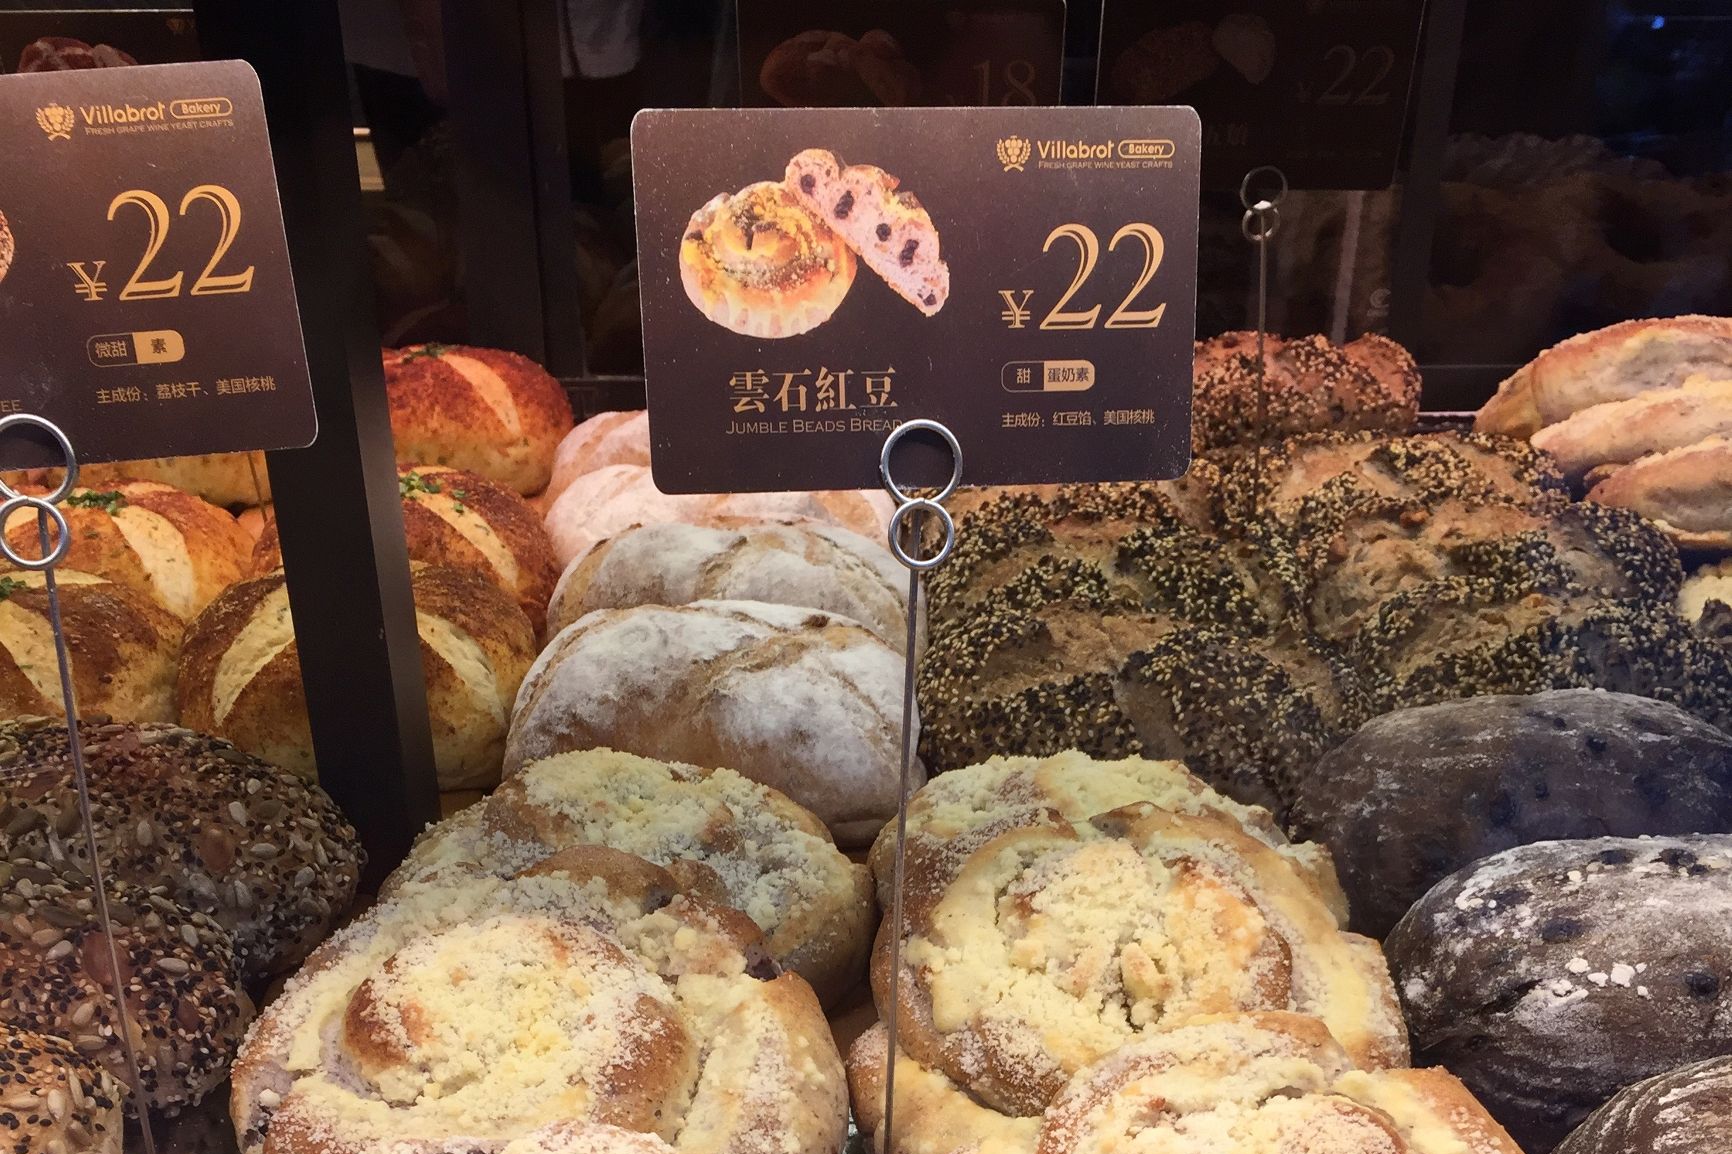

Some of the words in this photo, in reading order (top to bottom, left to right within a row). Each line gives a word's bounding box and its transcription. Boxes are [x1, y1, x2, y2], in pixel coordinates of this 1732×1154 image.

[80, 102, 165, 125] Villabrot
[181, 102, 221, 115] Bakery
[85, 126, 115, 136] FRESH
[171, 120, 198, 130] YEAST
[200, 119, 234, 129] CRAFTS
[1037, 140, 1114, 159] Villabrot
[1128, 143, 1165, 156] Bakery
[1038, 160, 1065, 169] FRESH
[1066, 160, 1093, 169] GRAPE
[1094, 160, 1114, 169] WINE
[1116, 160, 1140, 169] YEAST
[1142, 160, 1173, 169] CRAFTS
[95, 341, 128, 359] 微甜
[150, 337, 168, 355] 素
[1016, 368, 1031, 384] 甜
[1047, 367, 1089, 383] 蛋奶素
[728, 366, 898, 413] 雲石紅豆
[726, 419, 788, 435] JUMBLE
[793, 419, 846, 433] BEADS
